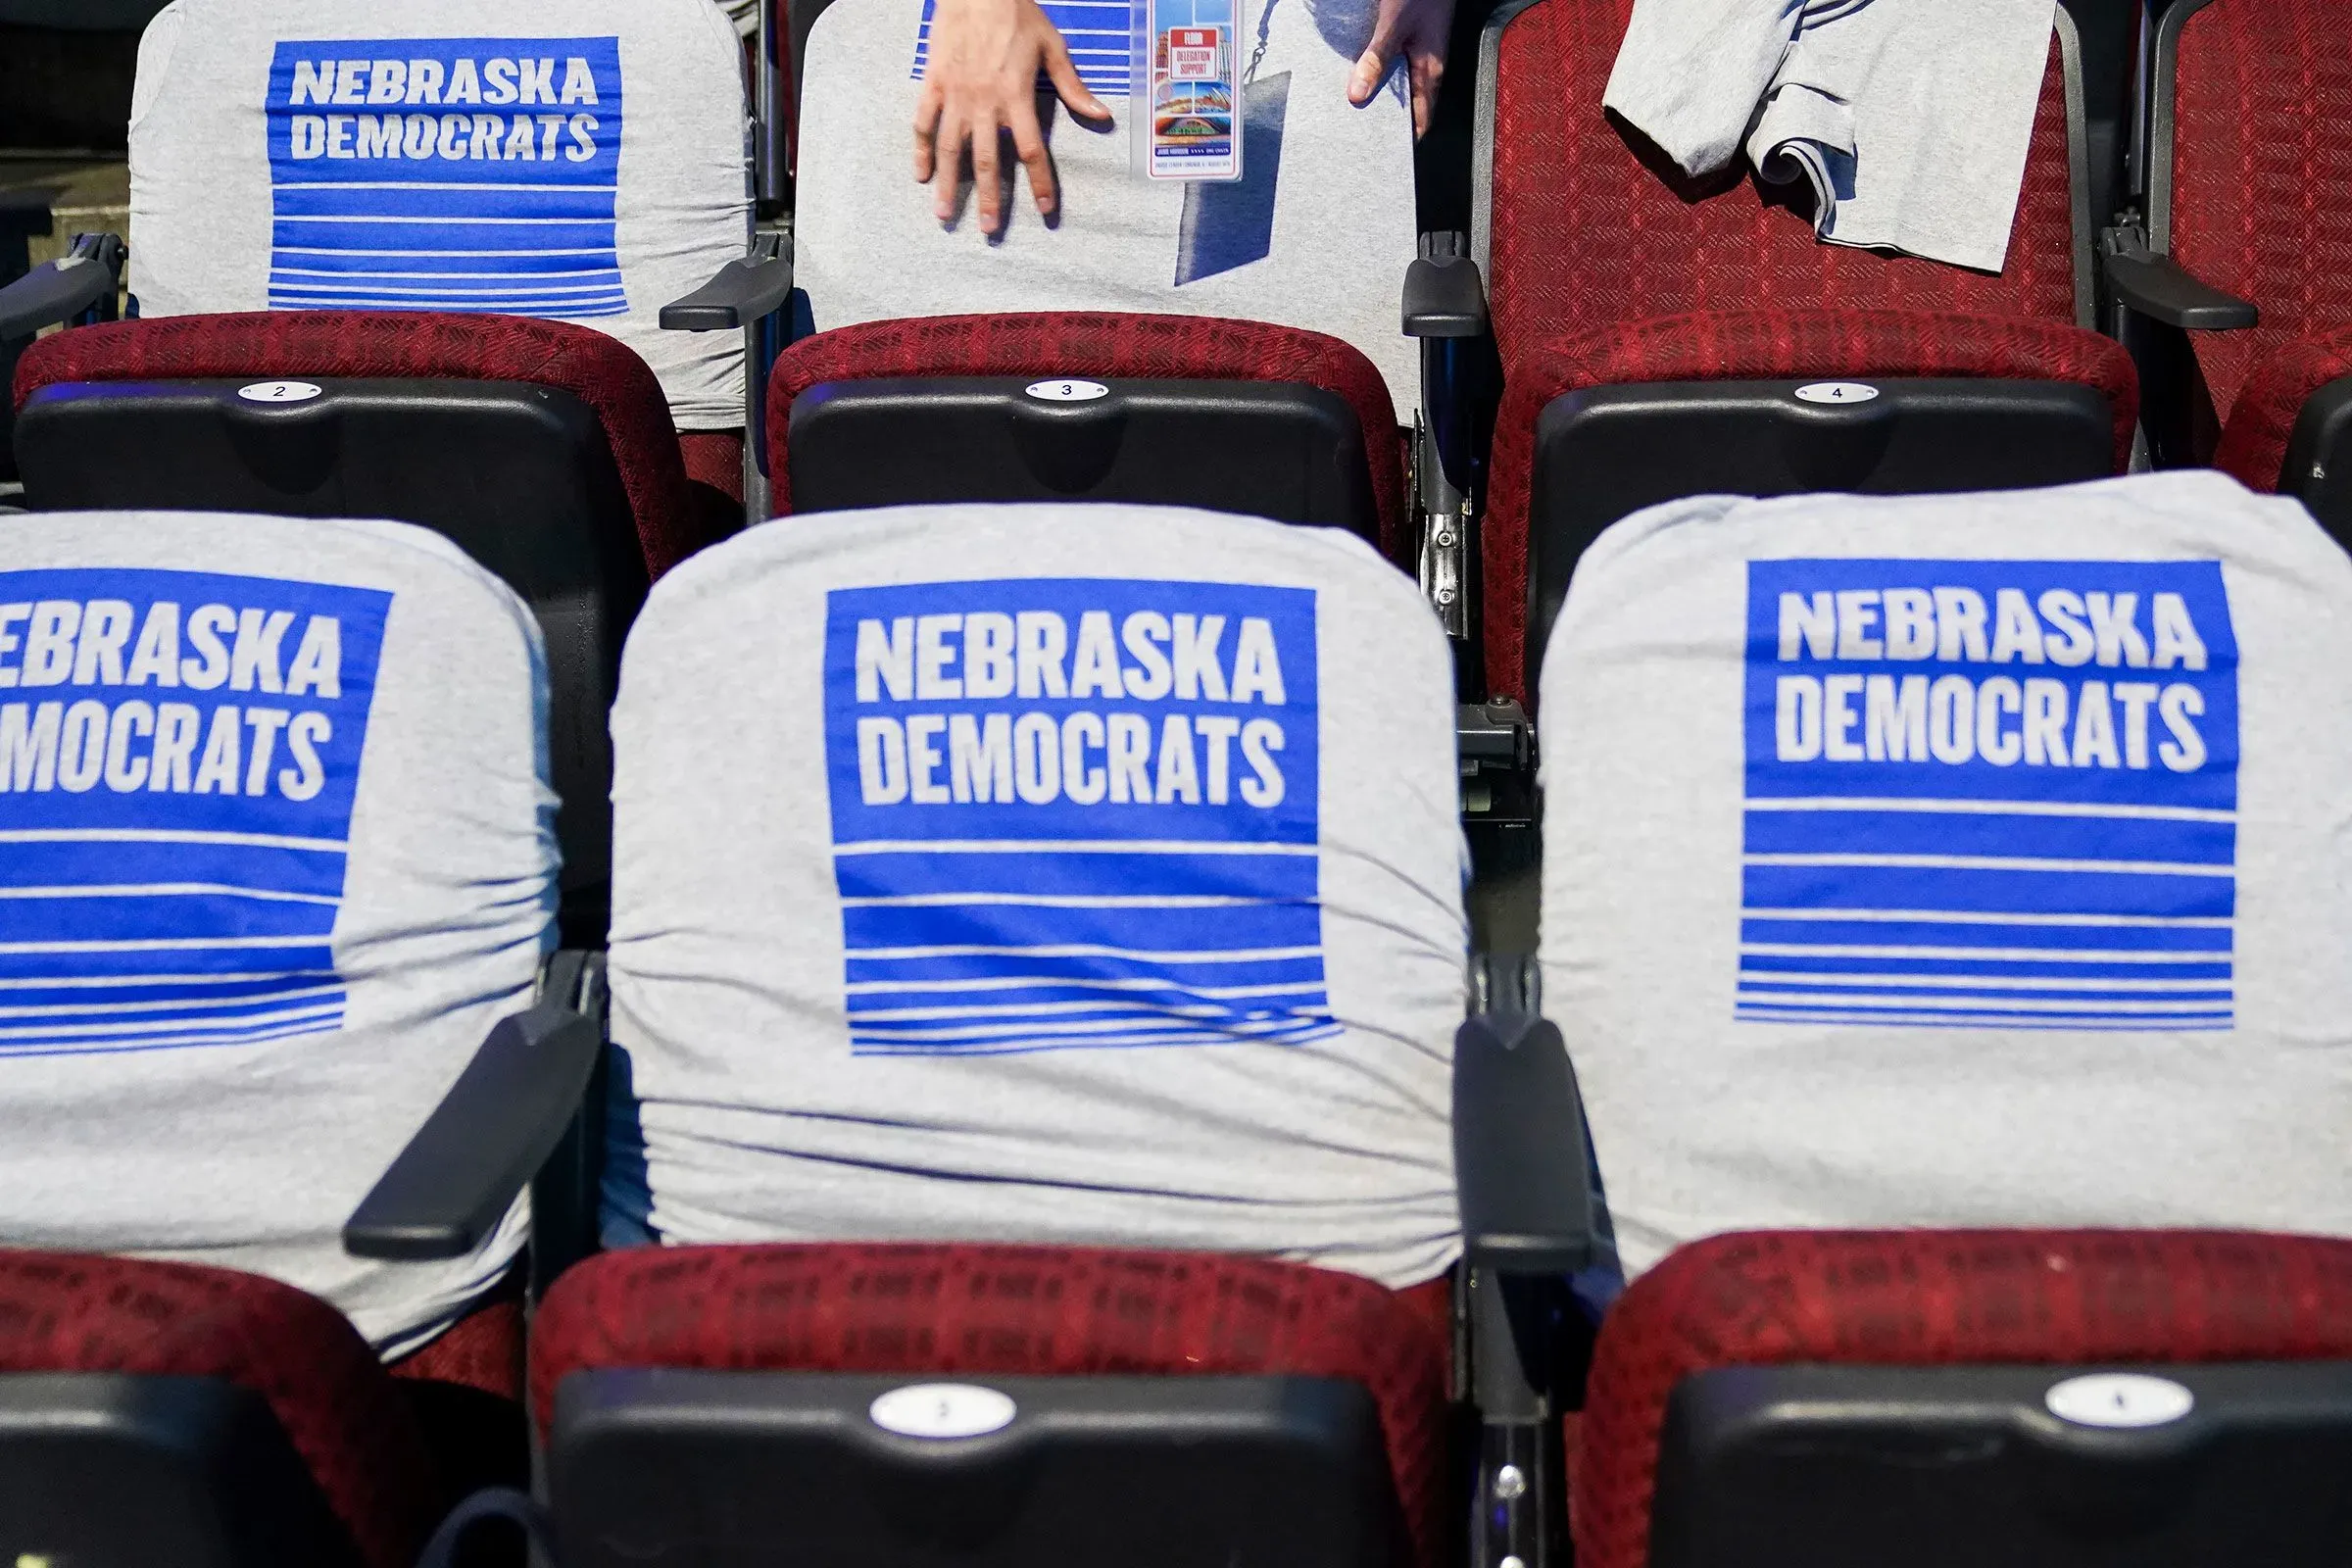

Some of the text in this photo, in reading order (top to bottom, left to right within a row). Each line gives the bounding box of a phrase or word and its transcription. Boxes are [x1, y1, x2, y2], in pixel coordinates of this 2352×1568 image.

[1176, 50, 1210, 62] DELEGATION
[1180, 64, 1207, 74] SUPPORT
[289, 57, 600, 105] NEBRASKA
[290, 113, 599, 163] DEMOCRATS
[272, 386, 286, 397] 2
[1060, 384, 1072, 396] 3
[1832, 387, 1843, 399] 4
[0, 599, 342, 699] EBRASKA
[1777, 587, 2208, 671] NEBRASKA
[856, 610, 1287, 706] NEBRASKA
[1775, 673, 2208, 774] DEMOCRATS
[857, 710, 1287, 809] DEMOCRATS
